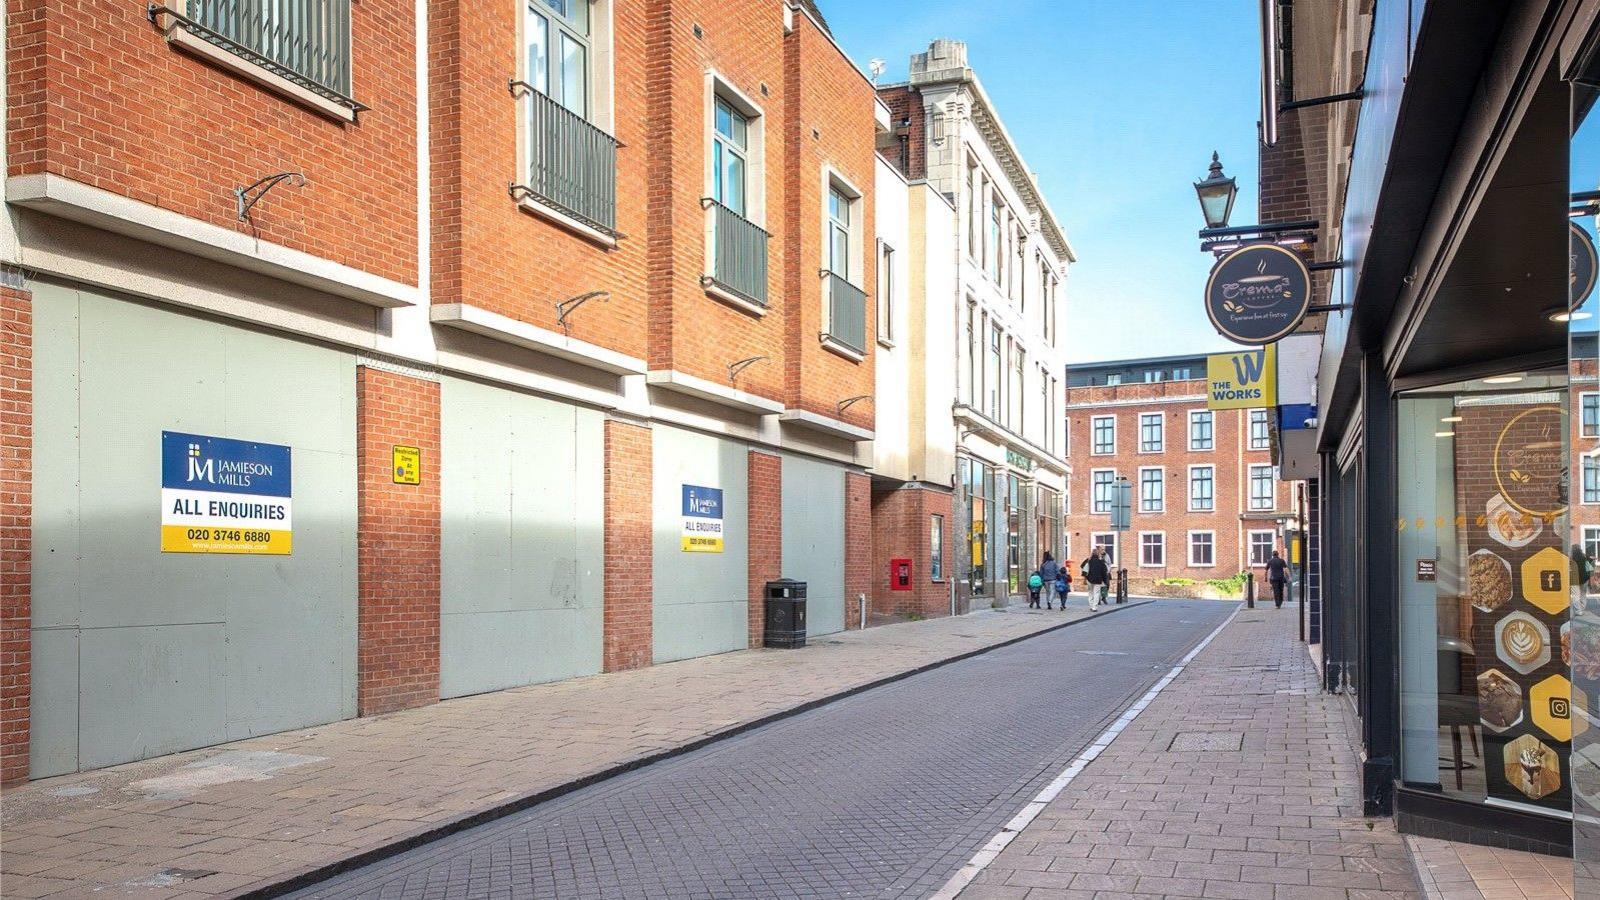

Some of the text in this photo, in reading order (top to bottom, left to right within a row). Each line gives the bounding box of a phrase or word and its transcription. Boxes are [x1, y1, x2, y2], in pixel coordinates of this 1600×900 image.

[1232, 351, 1265, 386] W
[1212, 388, 1261, 400] WORKS
[395, 447, 418, 456] Restricted
[218, 460, 273, 476] JAMIESON
[218, 474, 251, 487] MILLS
[173, 498, 285, 520] ALL ENQUIRIES
[685, 521, 721, 533] ALL ENQUIRIES
[187, 528, 271, 543] 020 3746 6880
